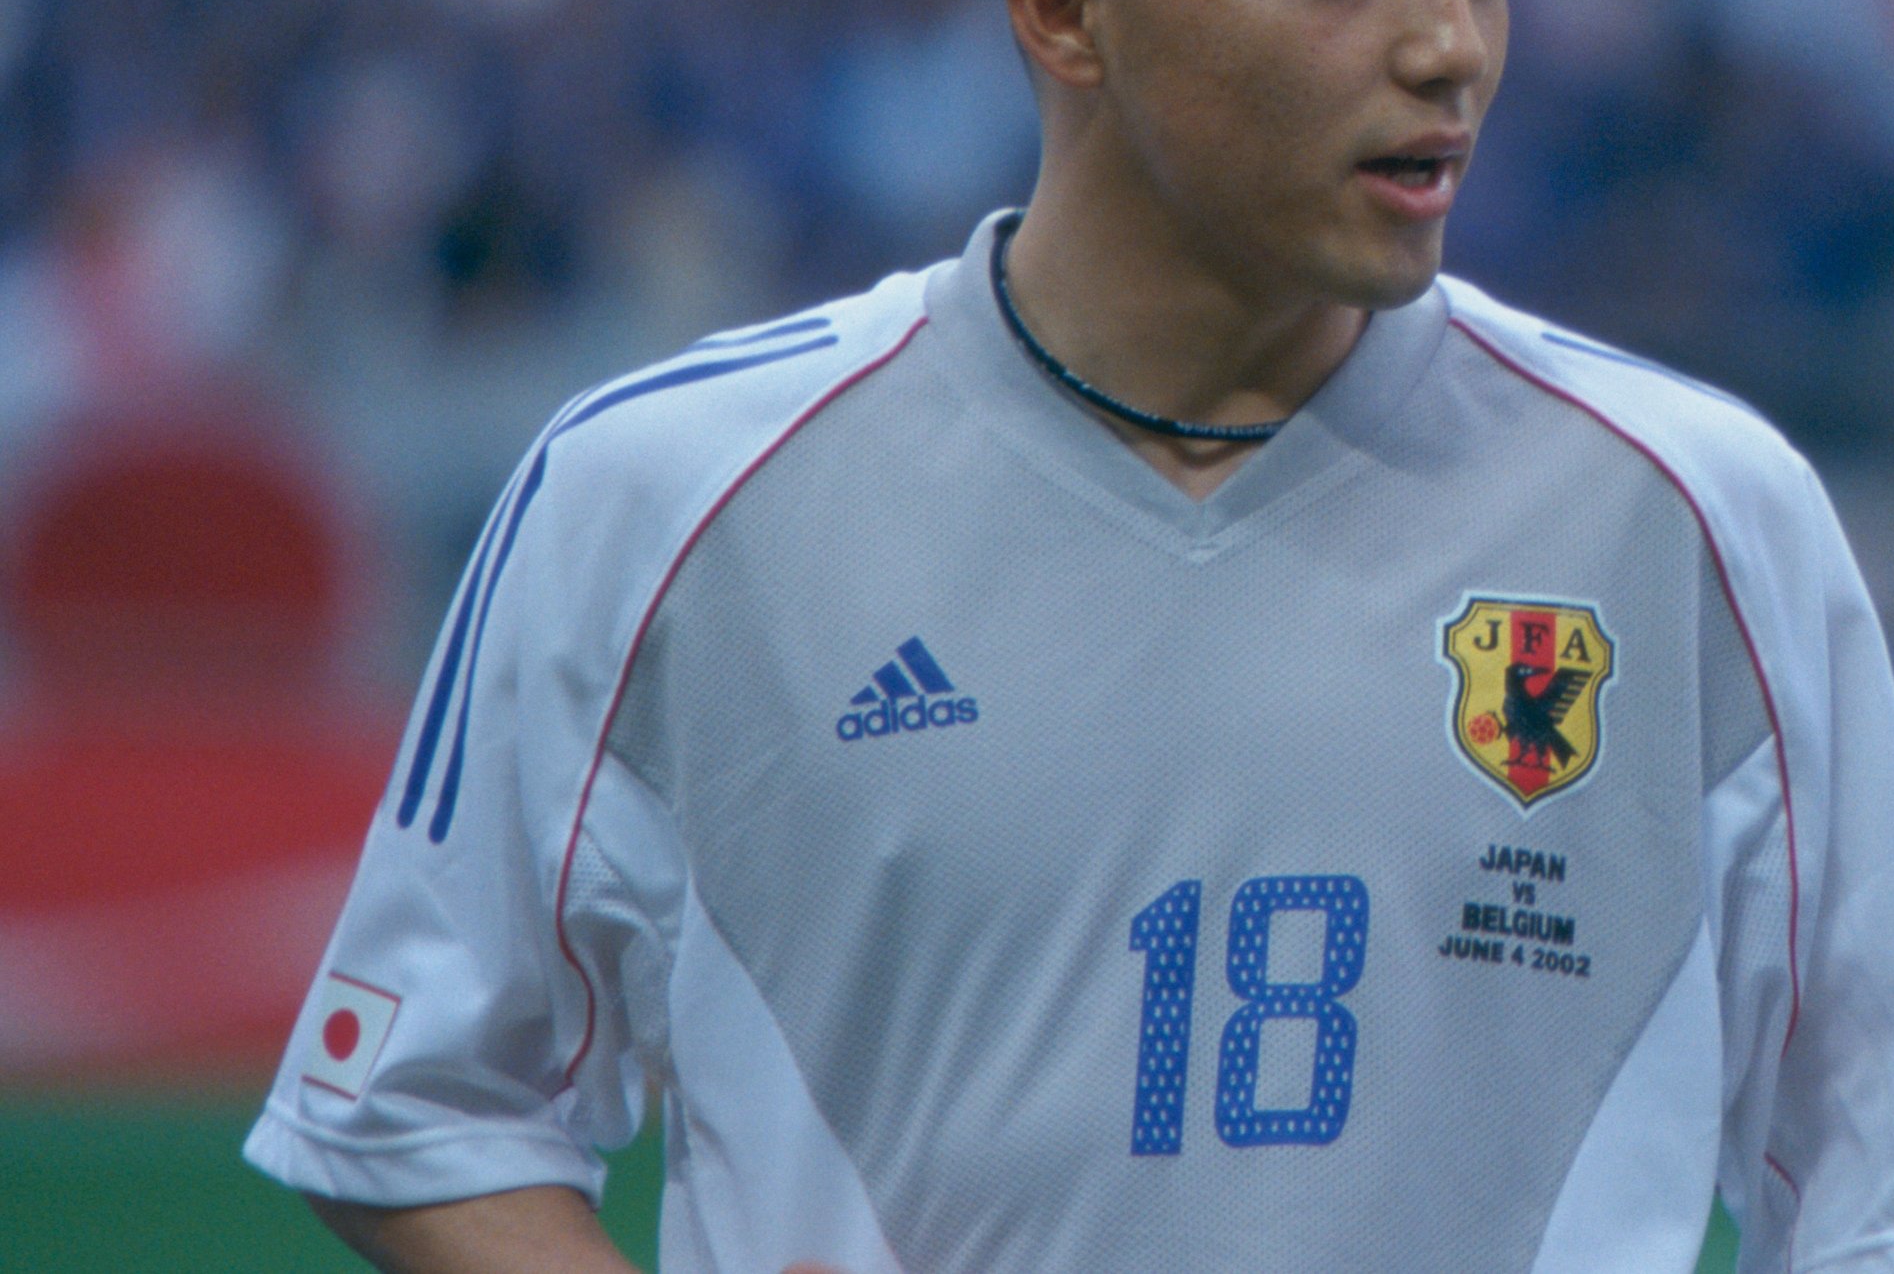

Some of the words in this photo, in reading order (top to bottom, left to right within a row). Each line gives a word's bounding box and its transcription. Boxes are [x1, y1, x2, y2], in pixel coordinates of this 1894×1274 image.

[836, 693, 979, 741] adidas
[1480, 844, 1566, 882] JAPAN
[1513, 881, 1535, 905] VS
[1462, 902, 1575, 945] BELGIUM
[1438, 936, 1504, 964] JUNE
[1511, 943, 1525, 965] 4
[1531, 949, 1591, 978] 2002
[1129, 875, 1369, 1155] 18
